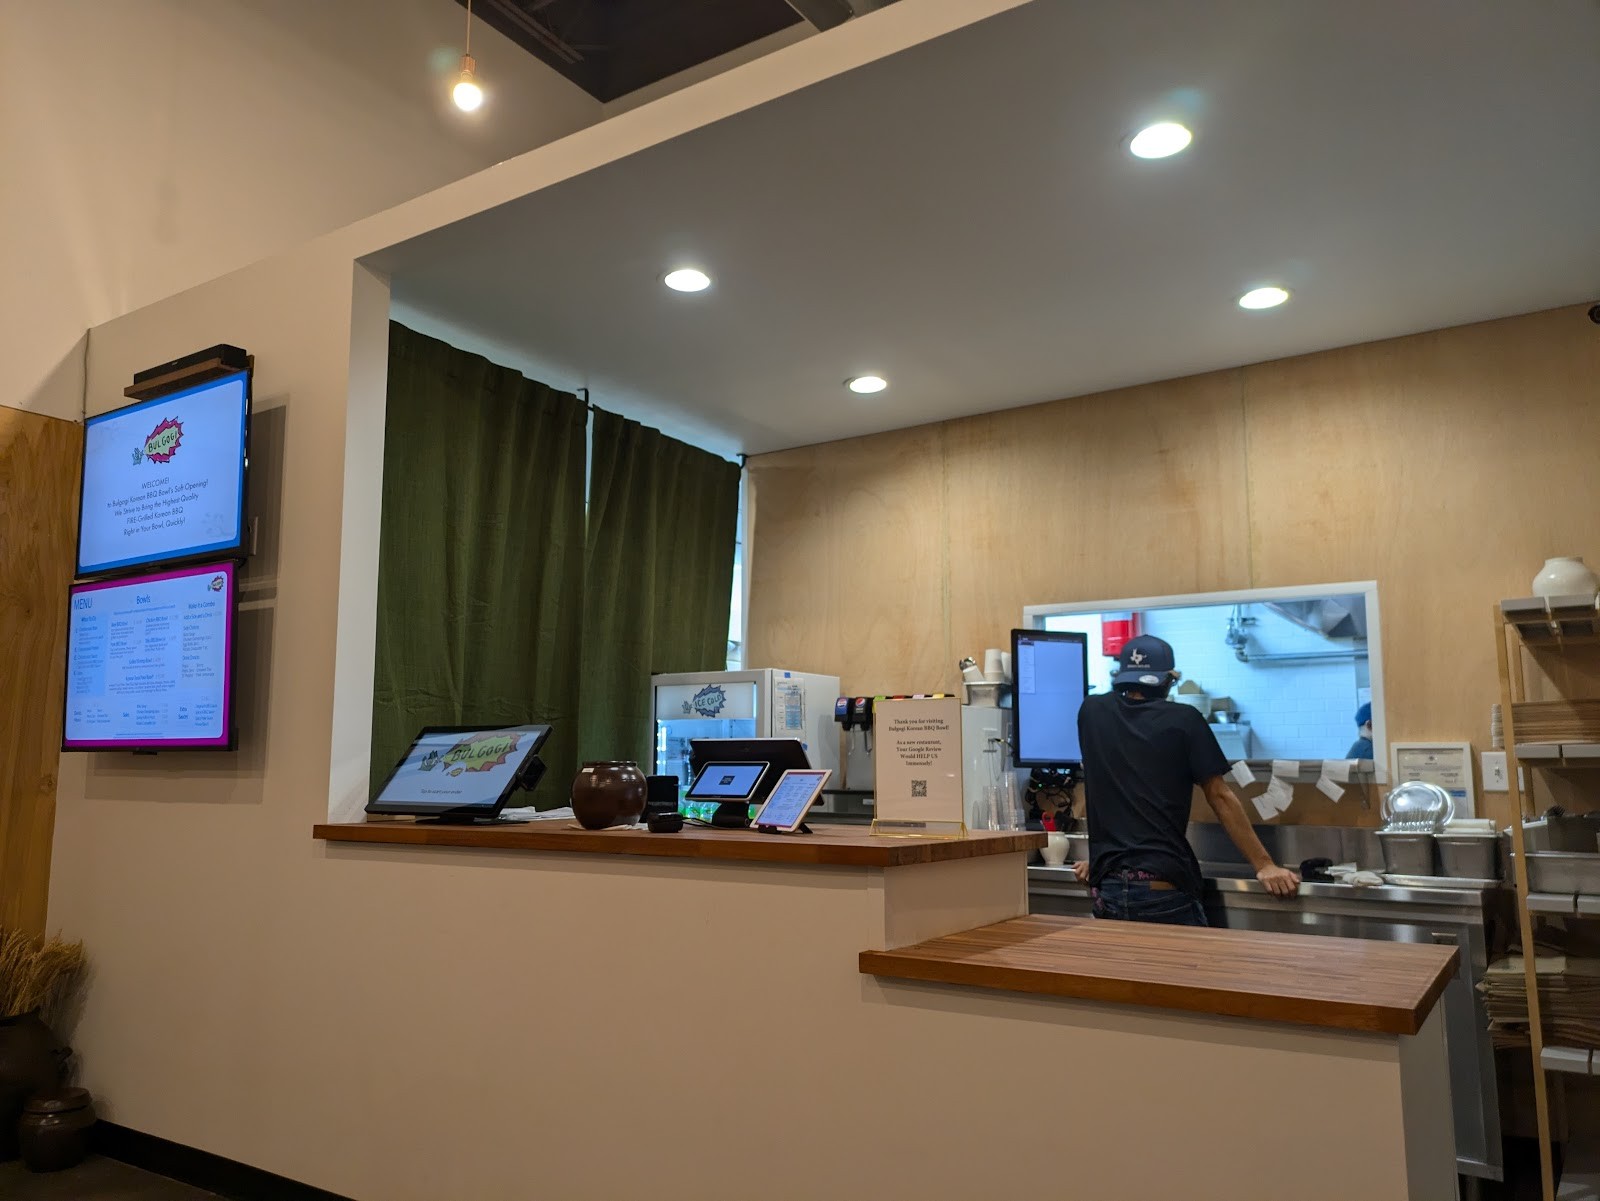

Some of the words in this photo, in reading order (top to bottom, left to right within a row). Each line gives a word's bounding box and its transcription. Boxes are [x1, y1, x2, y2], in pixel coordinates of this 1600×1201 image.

[148, 431, 177, 452] BULGOGI
[142, 477, 169, 489] WELCOME!
[130, 495, 146, 503] Korean
[146, 491, 158, 499] BBQ
[185, 479, 208, 491] Opening!
[180, 492, 199, 502] Quality
[154, 511, 171, 519] Korean
[172, 506, 184, 515] BBQ
[165, 517, 186, 528] Quickly!
[74, 597, 93, 610] MENU
[136, 594, 151, 605] Bowls
[694, 699, 706, 707] ICE
[707, 694, 722, 705] COLD
[450, 743, 510, 761] BULGOGI
